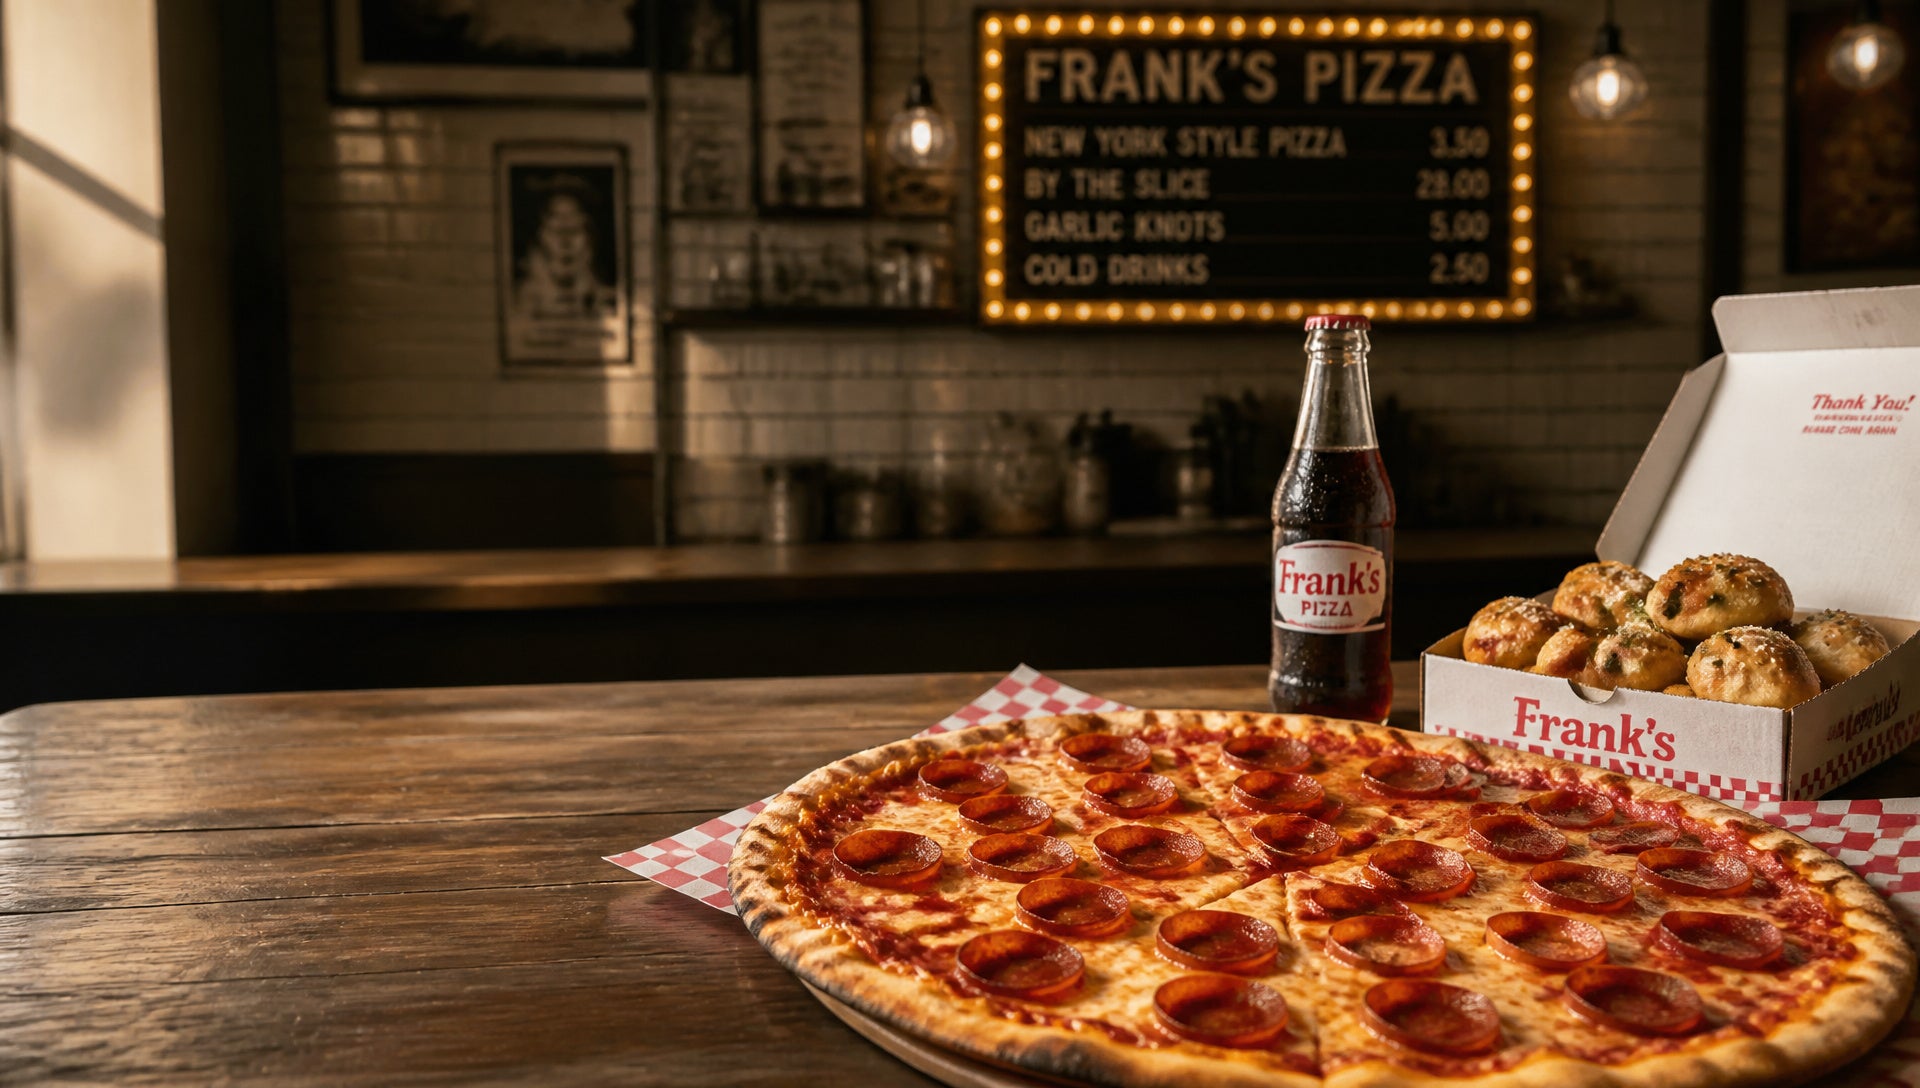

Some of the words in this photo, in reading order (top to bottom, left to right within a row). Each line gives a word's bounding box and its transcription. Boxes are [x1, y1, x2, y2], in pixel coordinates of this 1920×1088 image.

[1025, 48, 1278, 102] FRANK'S
[1305, 50, 1478, 103] PIZZA
[1024, 126, 1086, 157] NEW
[1095, 126, 1168, 157] YORK
[1177, 126, 1260, 157] STYLE
[1268, 126, 1348, 158] PIZZA
[1024, 168, 1061, 199] BY
[1071, 168, 1124, 199] THE
[1134, 168, 1210, 199] SLICE
[1024, 210, 1124, 242] GARLIC
[1134, 210, 1226, 242] KNOTS
[1429, 210, 1490, 242] 5.00
[1024, 253, 1098, 285] COLD
[1107, 253, 1210, 285] DRINKS
[1429, 252, 1490, 284] 2.50
[1812, 393, 1866, 410] Thank
[1871, 394, 1916, 411] You!
[1279, 559, 1380, 596] Frank's
[1301, 600, 1353, 617] PIZZA
[1512, 696, 1676, 762] Frank's
